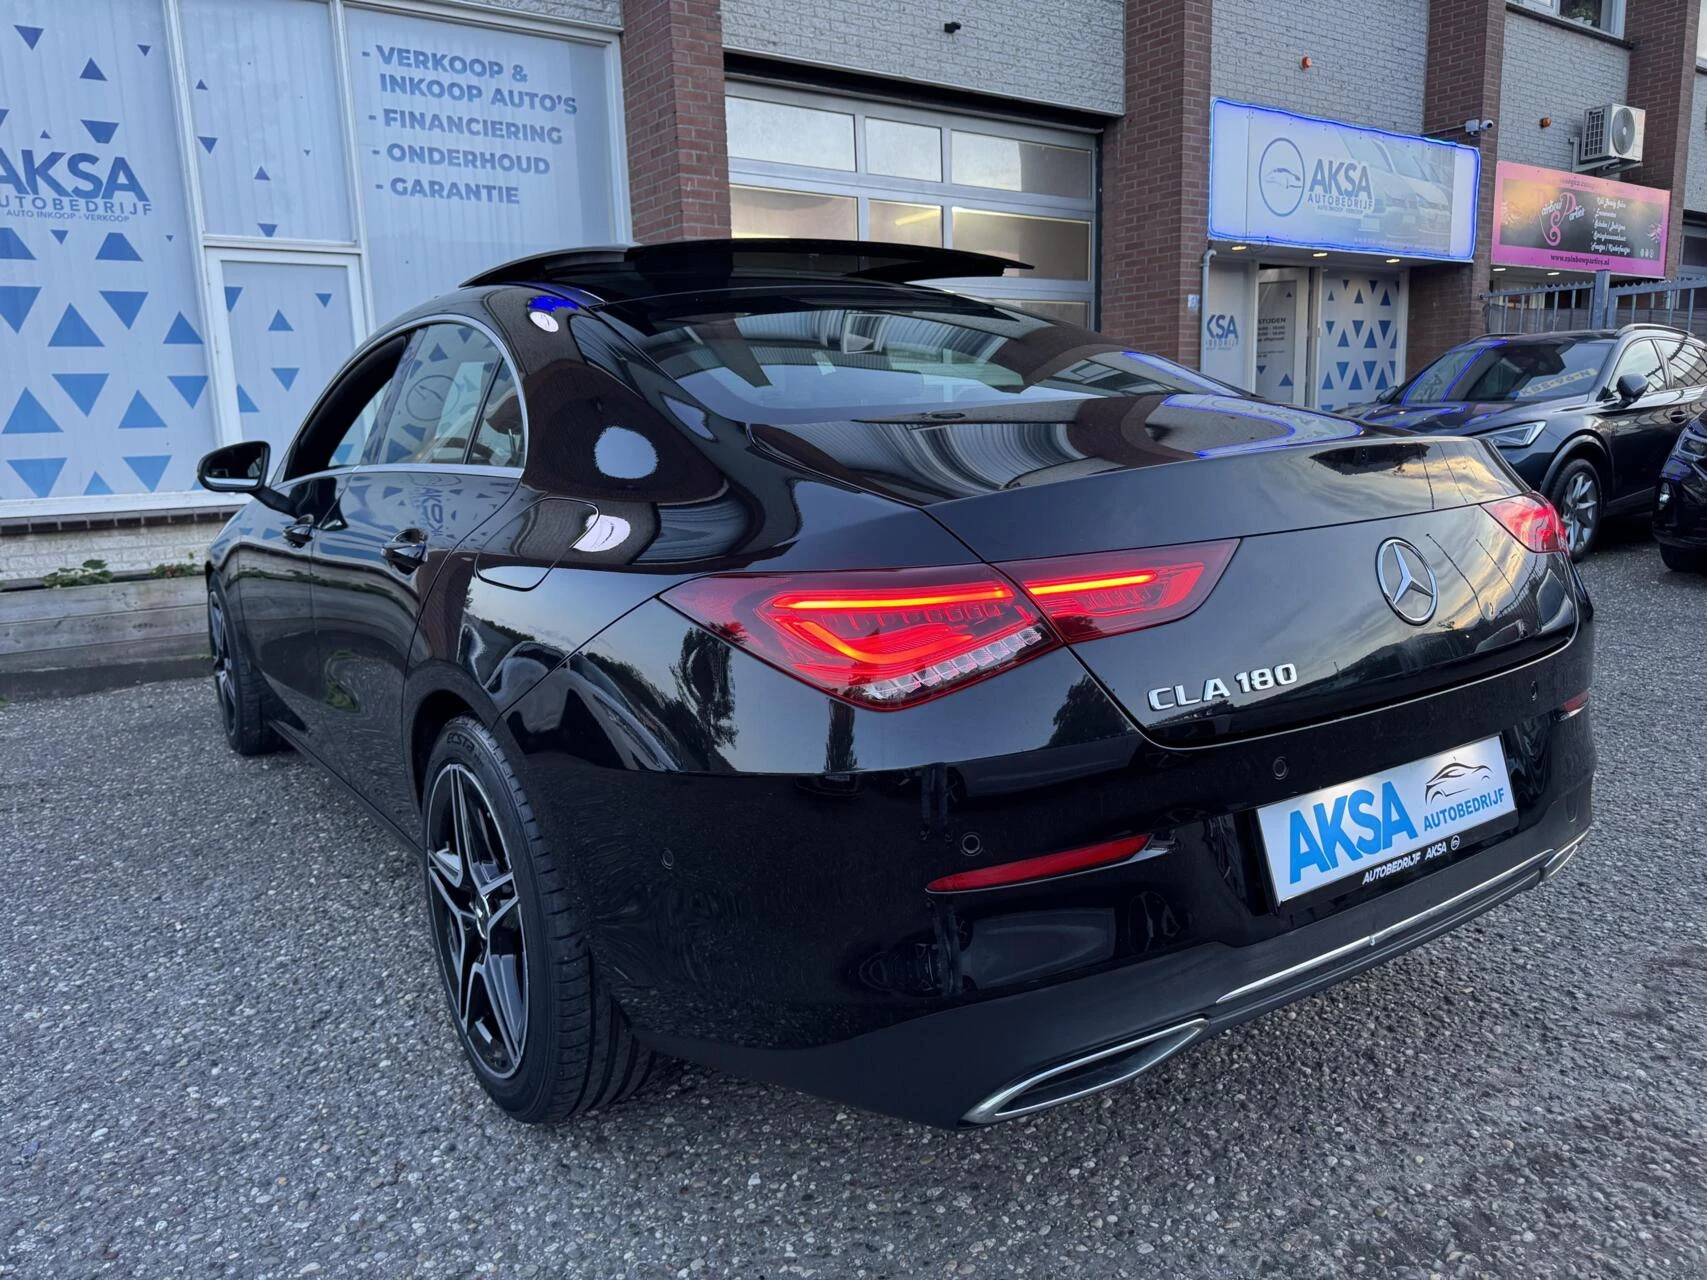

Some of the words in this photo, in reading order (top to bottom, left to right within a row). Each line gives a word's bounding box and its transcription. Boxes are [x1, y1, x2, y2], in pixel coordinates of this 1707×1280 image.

[375, 44, 504, 79] VERKOOP
[511, 64, 528, 82] &
[380, 73, 483, 103] INKOOP
[490, 87, 578, 115] AUTO'S
[383, 108, 563, 145] FINANCIERING
[0, 147, 151, 202] AKSA
[386, 142, 550, 175] ONDERHOUD
[1308, 157, 1373, 200] AKSA
[390, 177, 520, 205] GARANTIE
[1307, 192, 1374, 211] AUTOBEDRIJF
[6, 208, 34, 218] AUTO
[36, 210, 76, 221] INKOOP
[83, 213, 130, 224] VERKOOP
[1148, 677, 1231, 711] CLA
[1235, 662, 1298, 694] 180
[1424, 787, 1505, 832] AUTOBEDRIJF
[1289, 781, 1418, 884] AKSA
[1361, 851, 1422, 886] AUTOBEDRIJF
[1424, 840, 1448, 861] AKSA
